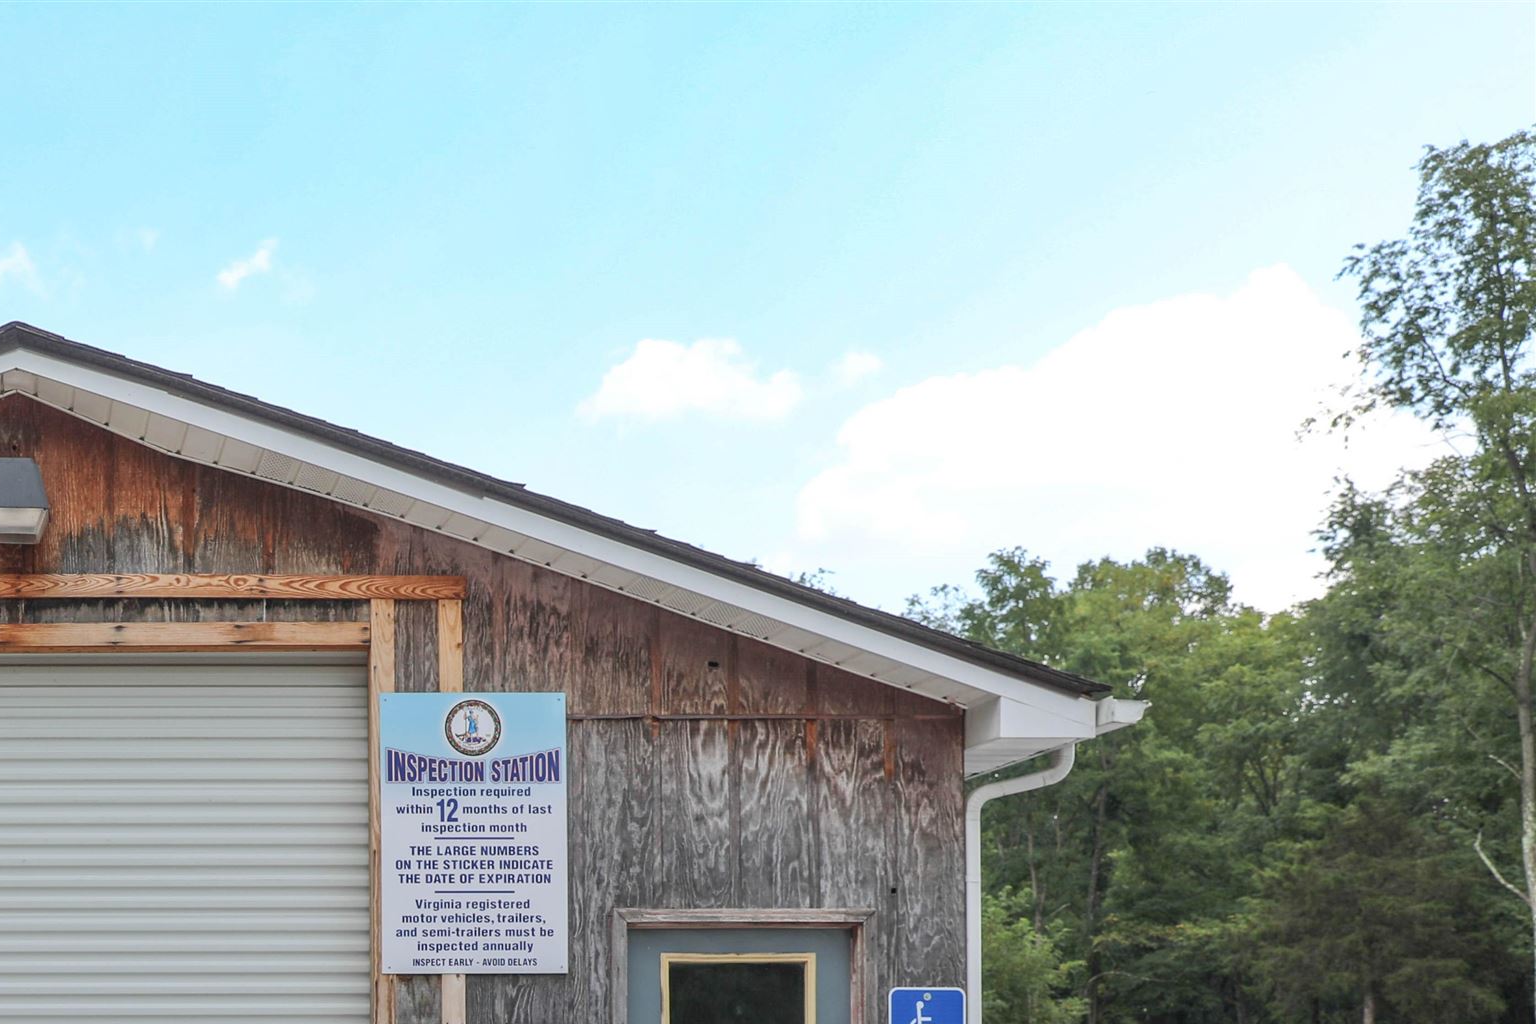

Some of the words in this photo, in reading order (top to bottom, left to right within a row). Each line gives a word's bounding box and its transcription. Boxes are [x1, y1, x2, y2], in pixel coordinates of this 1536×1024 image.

[386, 748, 485, 783] INSPECTION
[491, 748, 560, 783] STATION
[412, 787, 476, 798] Inspection
[480, 787, 531, 798] required
[396, 804, 433, 815] within
[436, 799, 458, 822] 12
[462, 804, 508, 815] months
[512, 804, 524, 815] of
[528, 804, 552, 815] last
[421, 823, 485, 835] inspection
[489, 823, 527, 833] month
[410, 846, 433, 856] THE
[437, 846, 476, 856] LARGE
[481, 846, 539, 856] NUMBERS
[395, 860, 410, 870] ON
[416, 860, 439, 870] THE
[443, 860, 495, 870] STICKER
[499, 860, 553, 870] INDICATE
[399, 874, 421, 884] THE
[425, 874, 456, 884] DATE
[460, 874, 474, 884] OF
[479, 874, 551, 884] EXPIRATION
[415, 899, 462, 912] Virginia
[466, 899, 530, 912] registered
[402, 914, 438, 923] motor
[441, 913, 494, 925] vehicles,
[497, 913, 546, 925] trailers,
[396, 927, 417, 937] and
[422, 927, 501, 937] semi-trailers
[505, 928, 536, 937] must
[540, 927, 554, 937] be
[417, 941, 478, 954] inspected
[482, 941, 533, 954] annually
[413, 958, 445, 966] INSPECT
[448, 958, 473, 966] EARLY
[482, 958, 505, 966] AVOID
[507, 958, 537, 966] DELAYS
